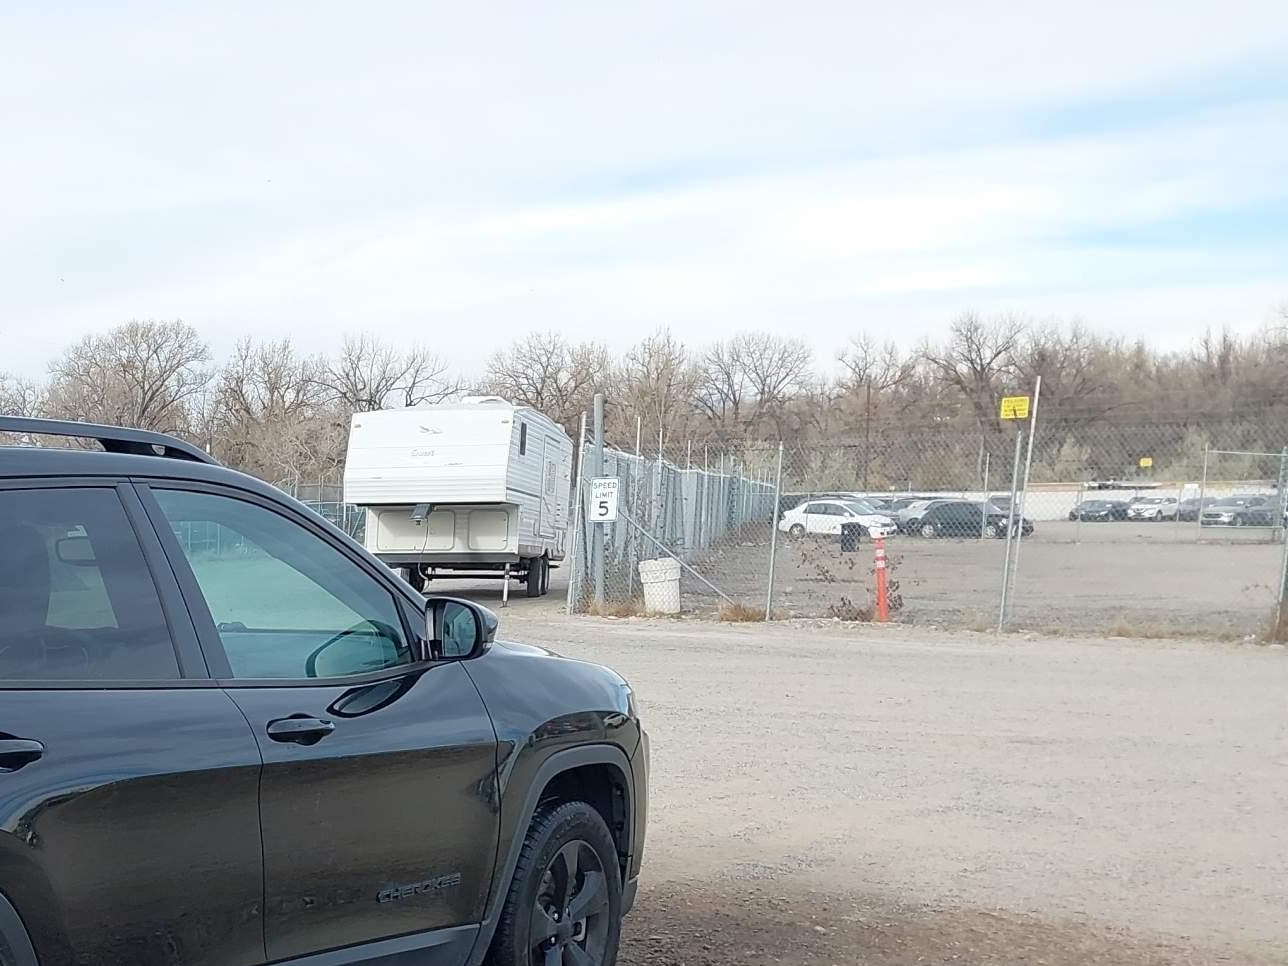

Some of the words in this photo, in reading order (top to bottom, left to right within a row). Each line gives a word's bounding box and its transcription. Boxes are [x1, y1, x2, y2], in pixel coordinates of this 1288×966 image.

[593, 481, 617, 489] SPEED
[595, 491, 614, 499] LIMIT
[598, 500, 609, 517] 5
